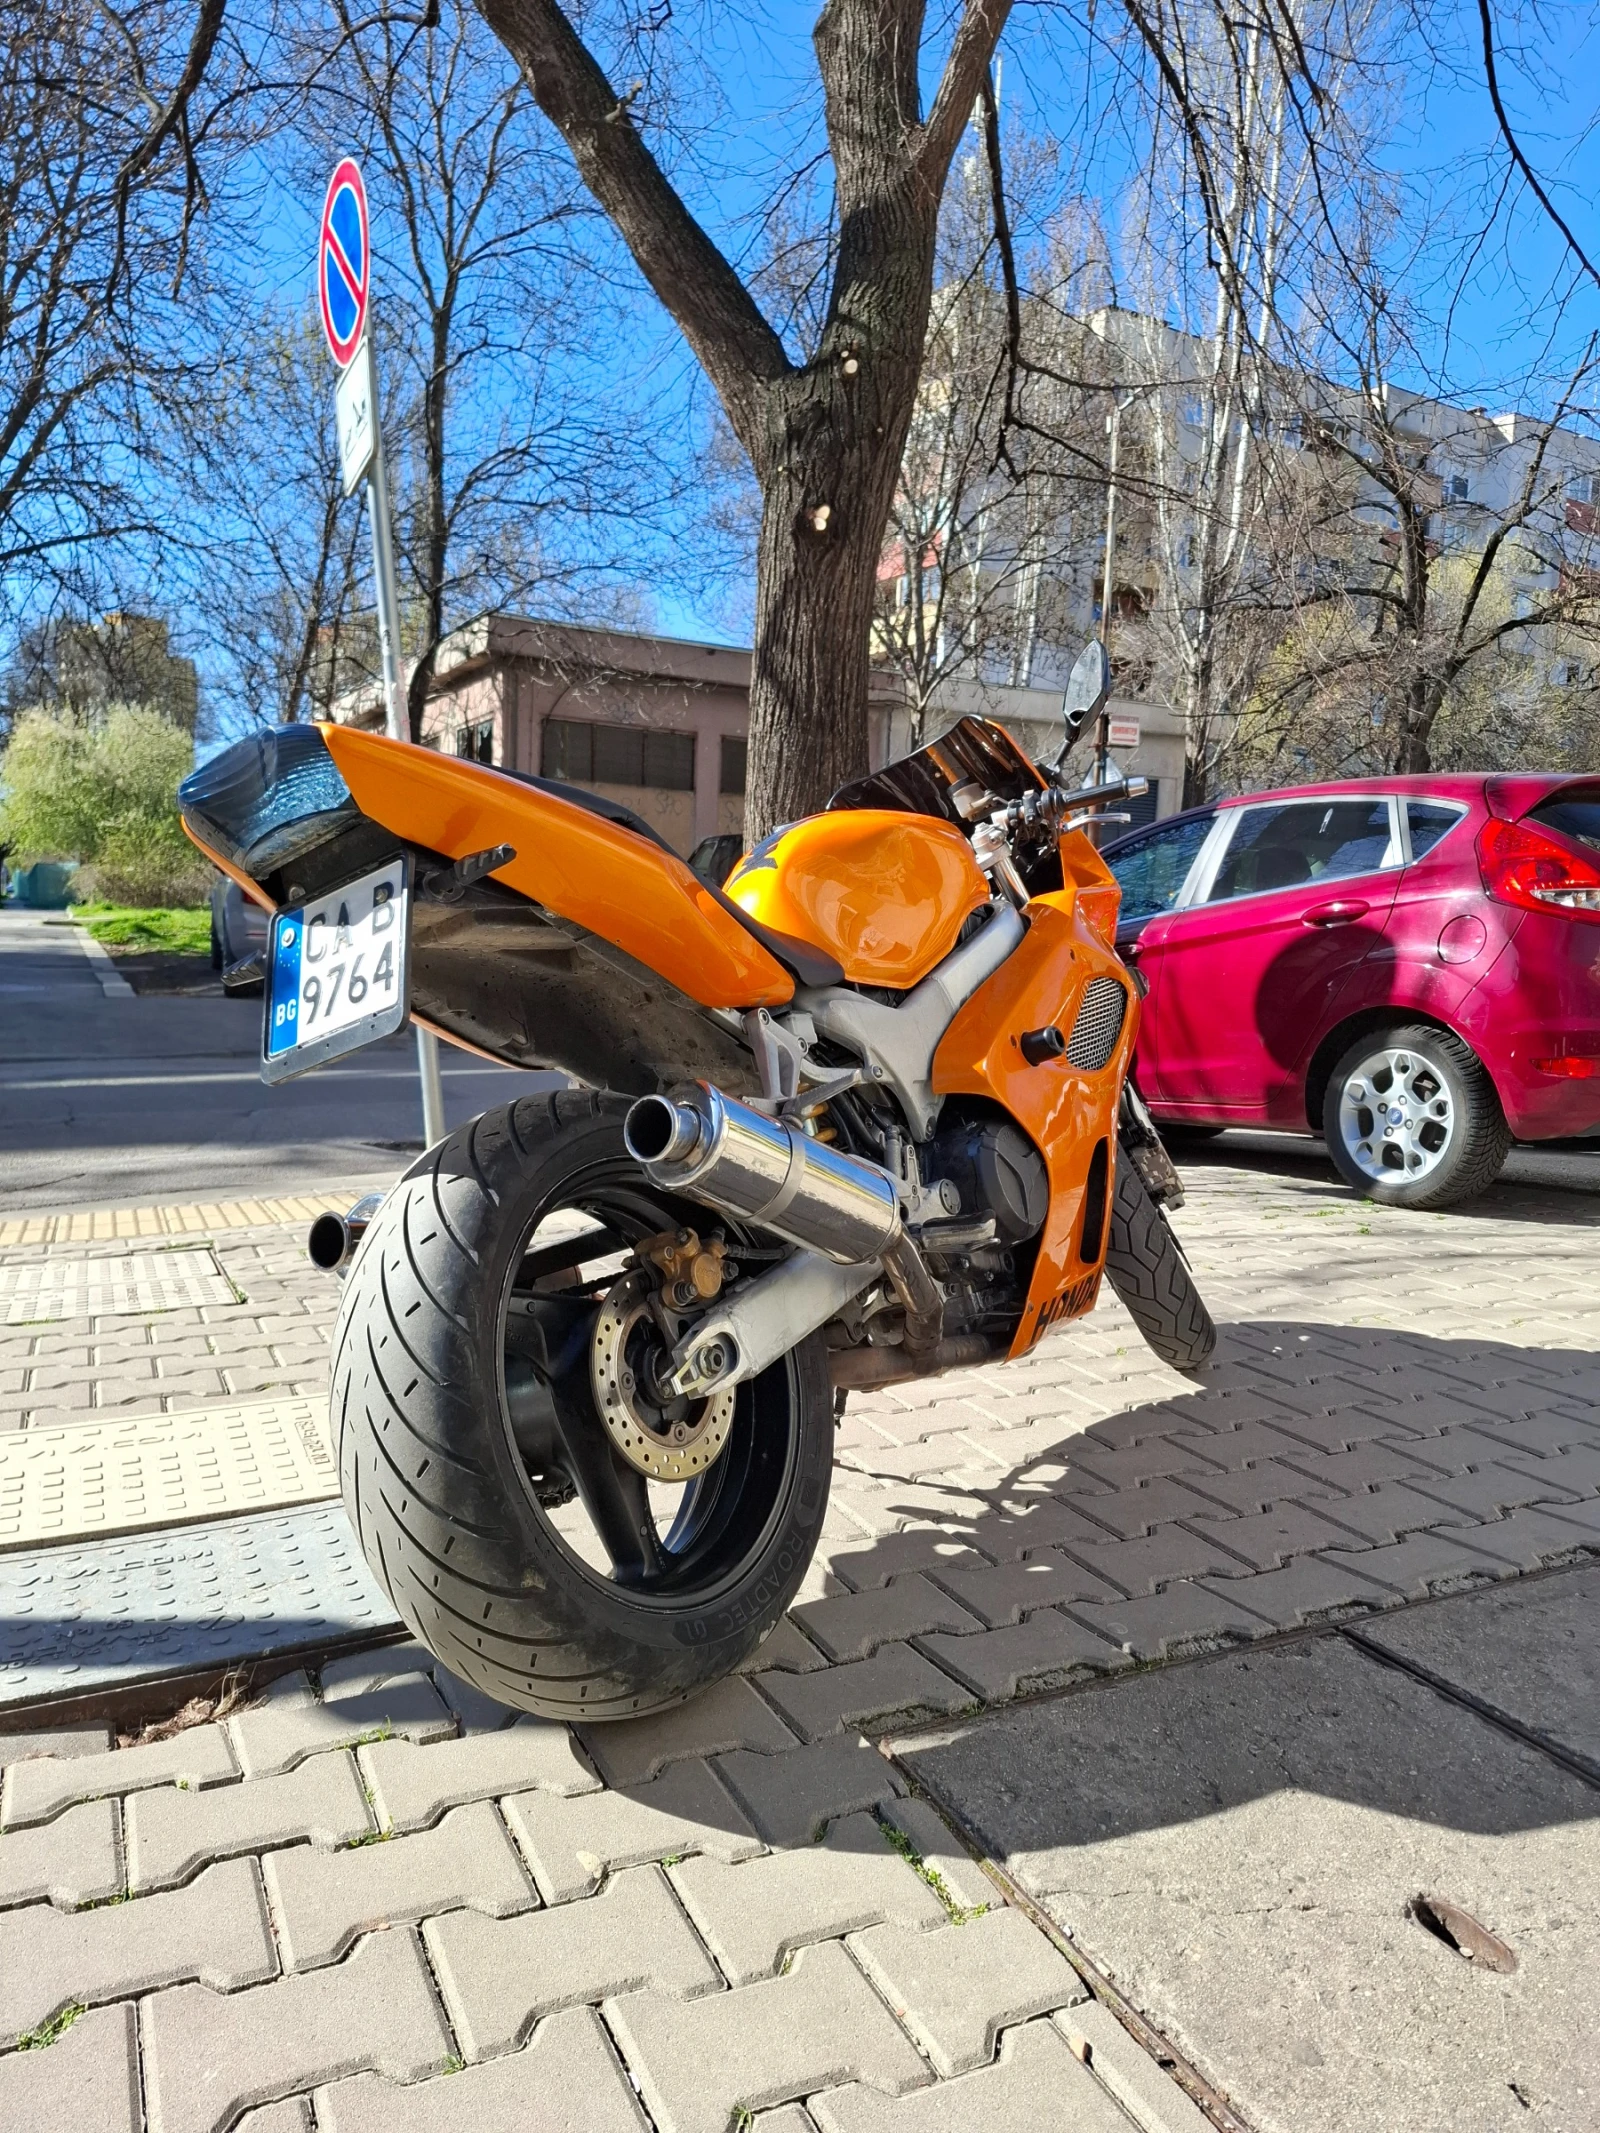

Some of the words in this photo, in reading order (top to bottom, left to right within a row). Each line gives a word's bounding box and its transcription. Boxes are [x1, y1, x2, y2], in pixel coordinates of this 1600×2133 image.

[306, 901, 354, 964] CA
[372, 881, 396, 936] B
[275, 999, 297, 1027] BG
[302, 940, 395, 1026] 9764
[1029, 1267, 1102, 1346] HONDA
[718, 1529, 806, 1633] ROADTEC
